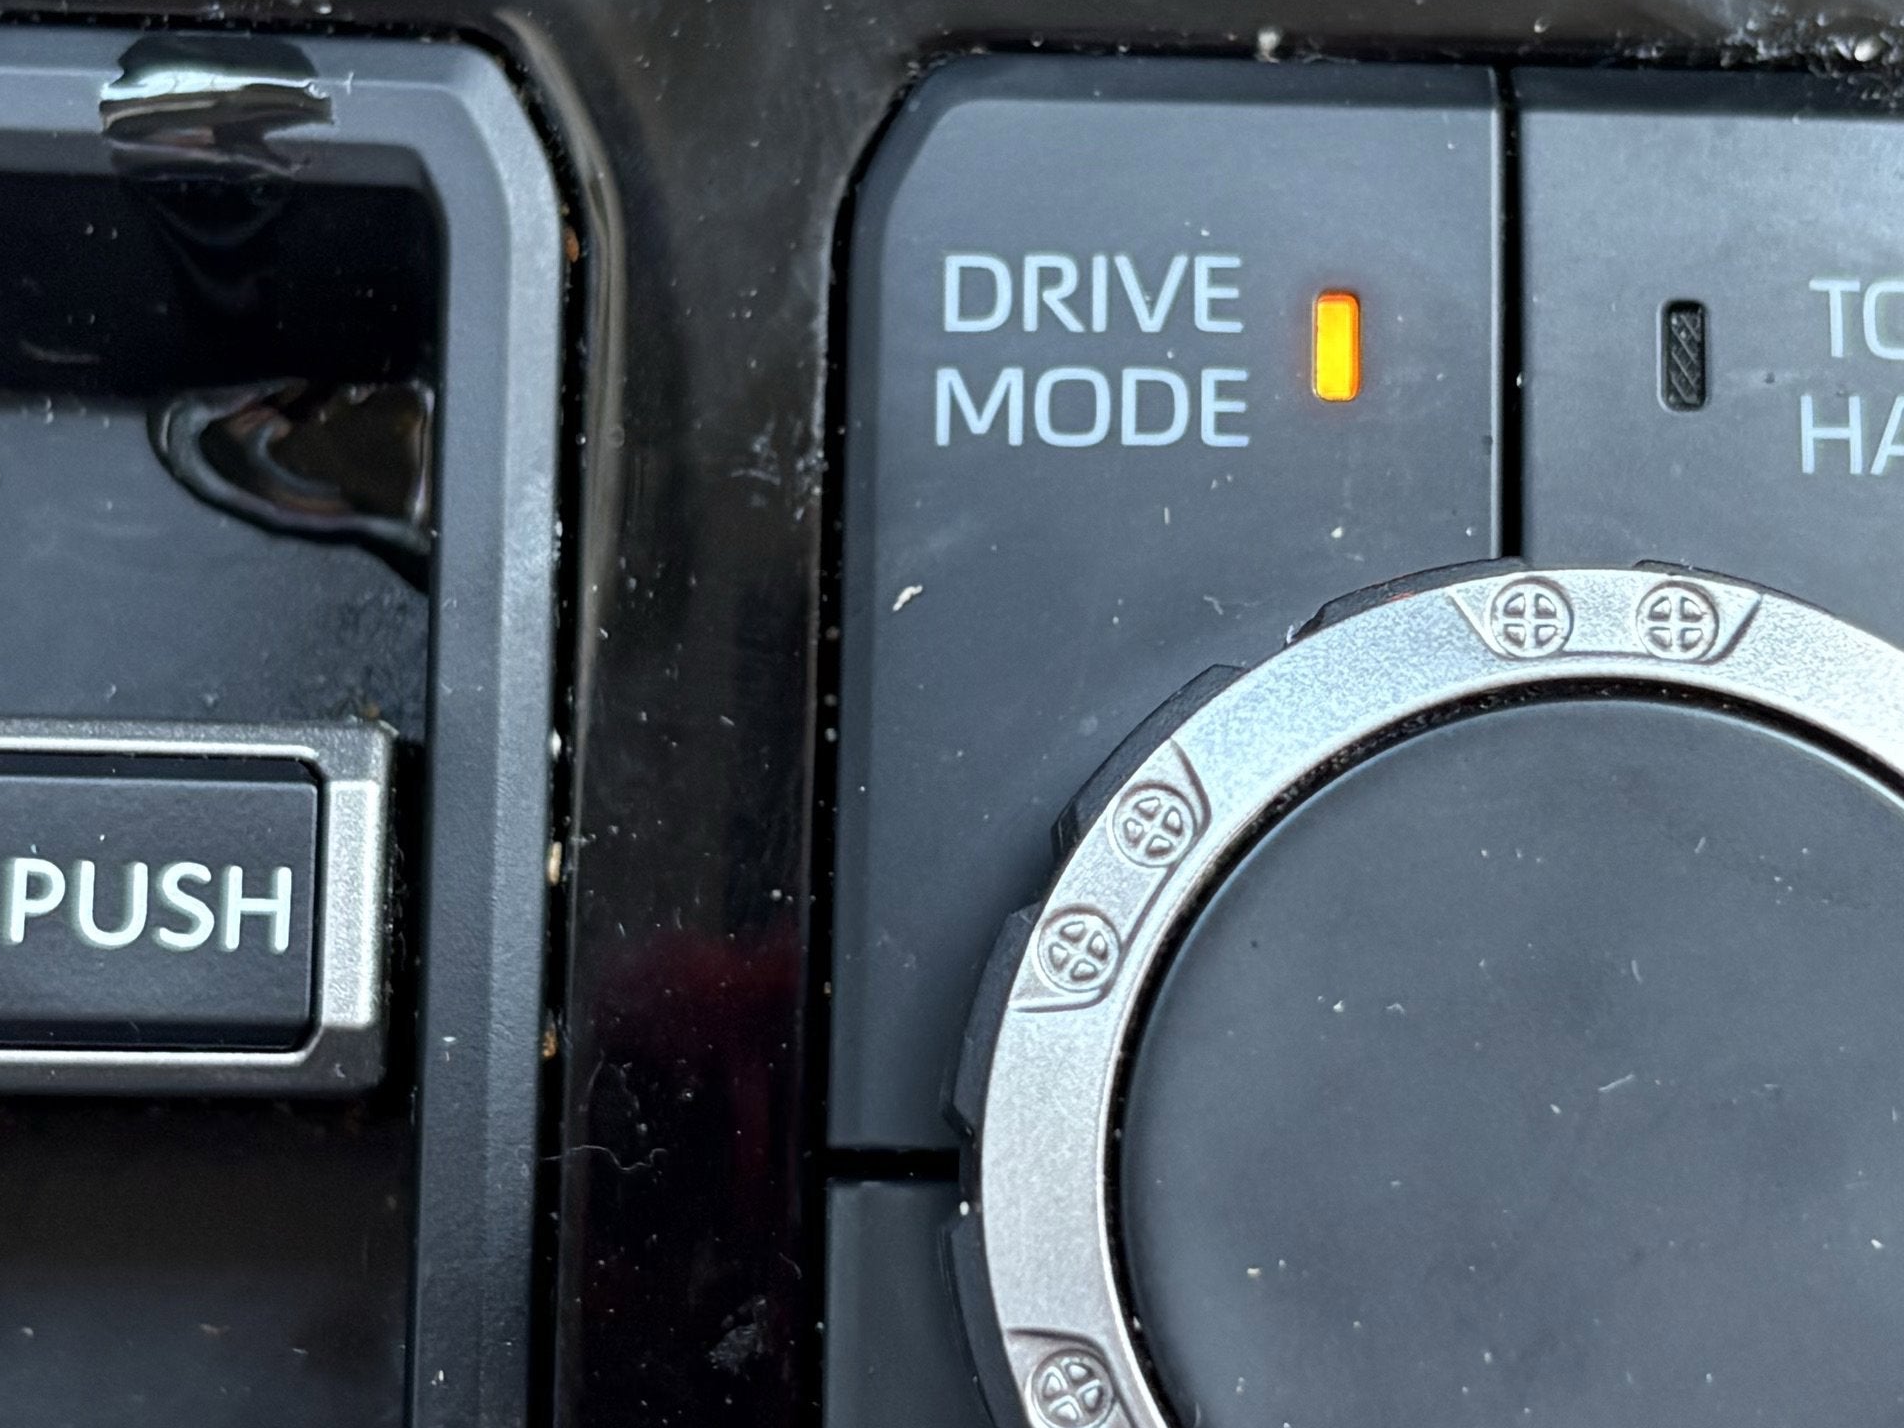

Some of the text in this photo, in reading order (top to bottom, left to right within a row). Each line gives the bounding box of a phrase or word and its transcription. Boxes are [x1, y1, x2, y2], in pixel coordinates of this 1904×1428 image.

[942, 252, 1246, 335] DRIVE
[934, 365, 1252, 449] MODE
[3, 855, 294, 954] PUSH
